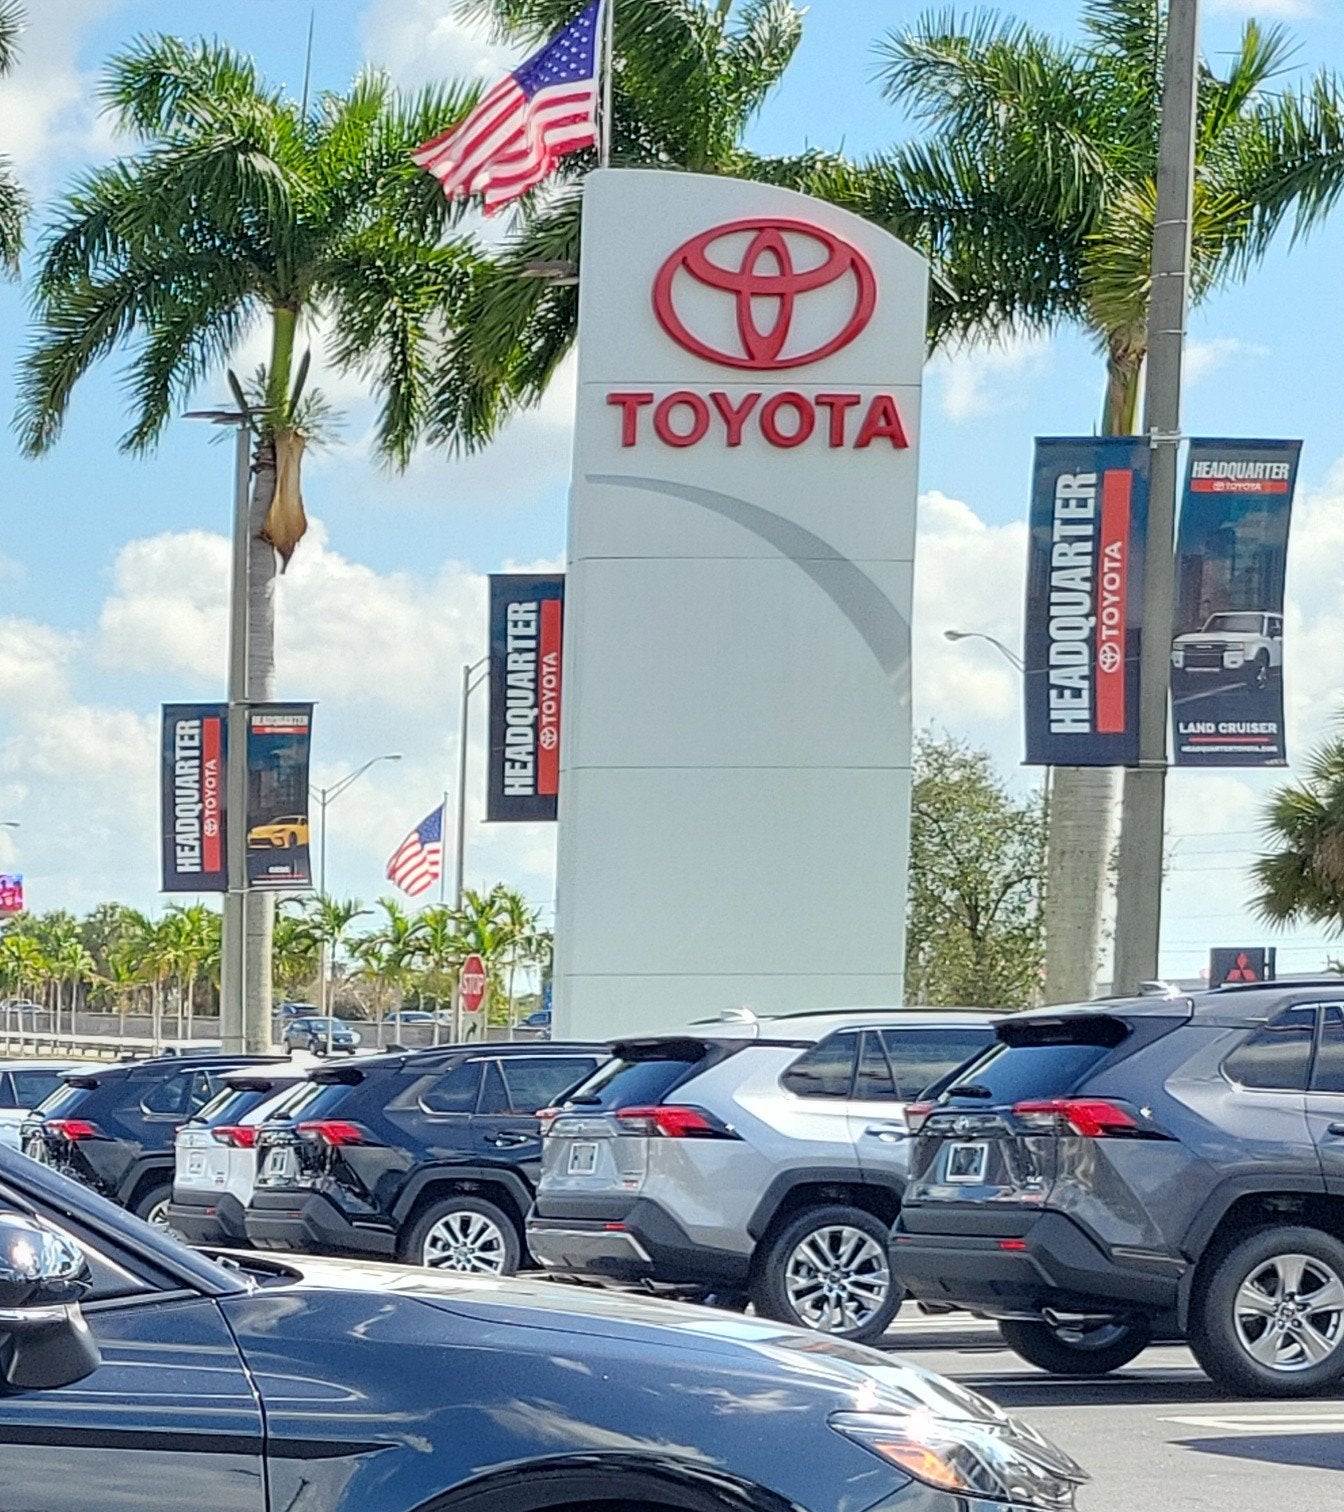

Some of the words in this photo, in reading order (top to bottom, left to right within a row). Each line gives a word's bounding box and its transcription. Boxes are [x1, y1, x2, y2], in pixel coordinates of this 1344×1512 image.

[606, 391, 909, 449] TOYOTA
[1192, 461, 1289, 480] HEADQUARTER
[1049, 472, 1097, 733] HEADQUARTER
[1102, 541, 1122, 640] TOYOTA
[503, 601, 538, 796] HEADQUARTER
[542, 652, 558, 725] TOYOTA
[1179, 722, 1216, 734] LAND
[1218, 722, 1278, 734] CRUISER
[175, 719, 203, 873] HEADQUARTER
[205, 759, 219, 817] TOYOTA
[463, 974, 484, 994] STOP
